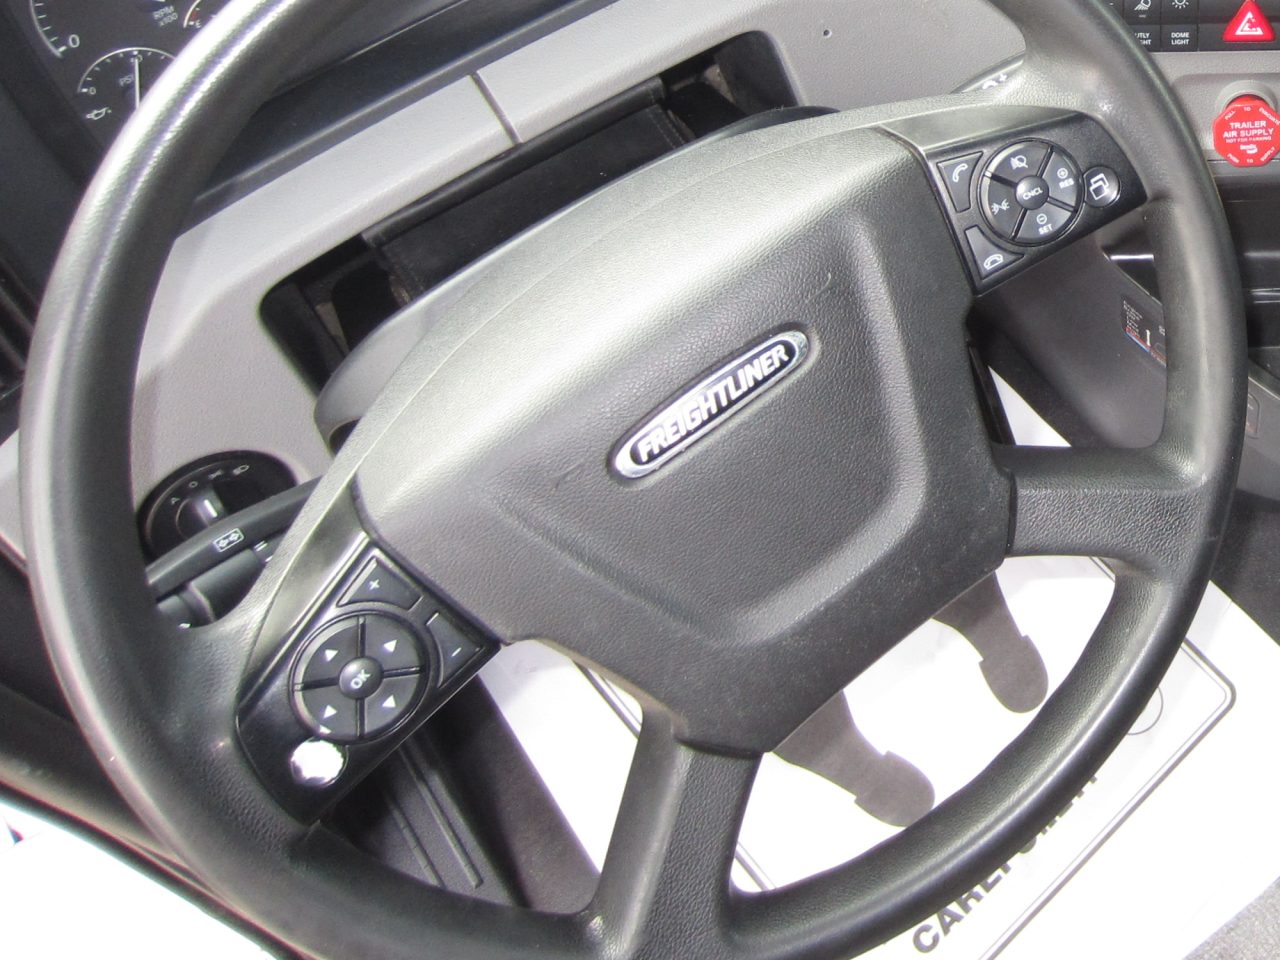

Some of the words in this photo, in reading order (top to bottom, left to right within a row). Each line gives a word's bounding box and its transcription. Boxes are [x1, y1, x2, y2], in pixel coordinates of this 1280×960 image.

[152, 5, 175, 21] RPM
[68, 34, 80, 48] 0
[1230, 120, 1267, 129] TRAILER
[1223, 130, 1238, 138] AIR
[1240, 128, 1274, 137] SUPPLY
[1058, 178, 1075, 189] RES
[1022, 186, 1043, 200] CNCL
[1038, 223, 1053, 235] SET
[636, 343, 790, 463] FREIGHTLINER
[350, 669, 371, 690] OK
